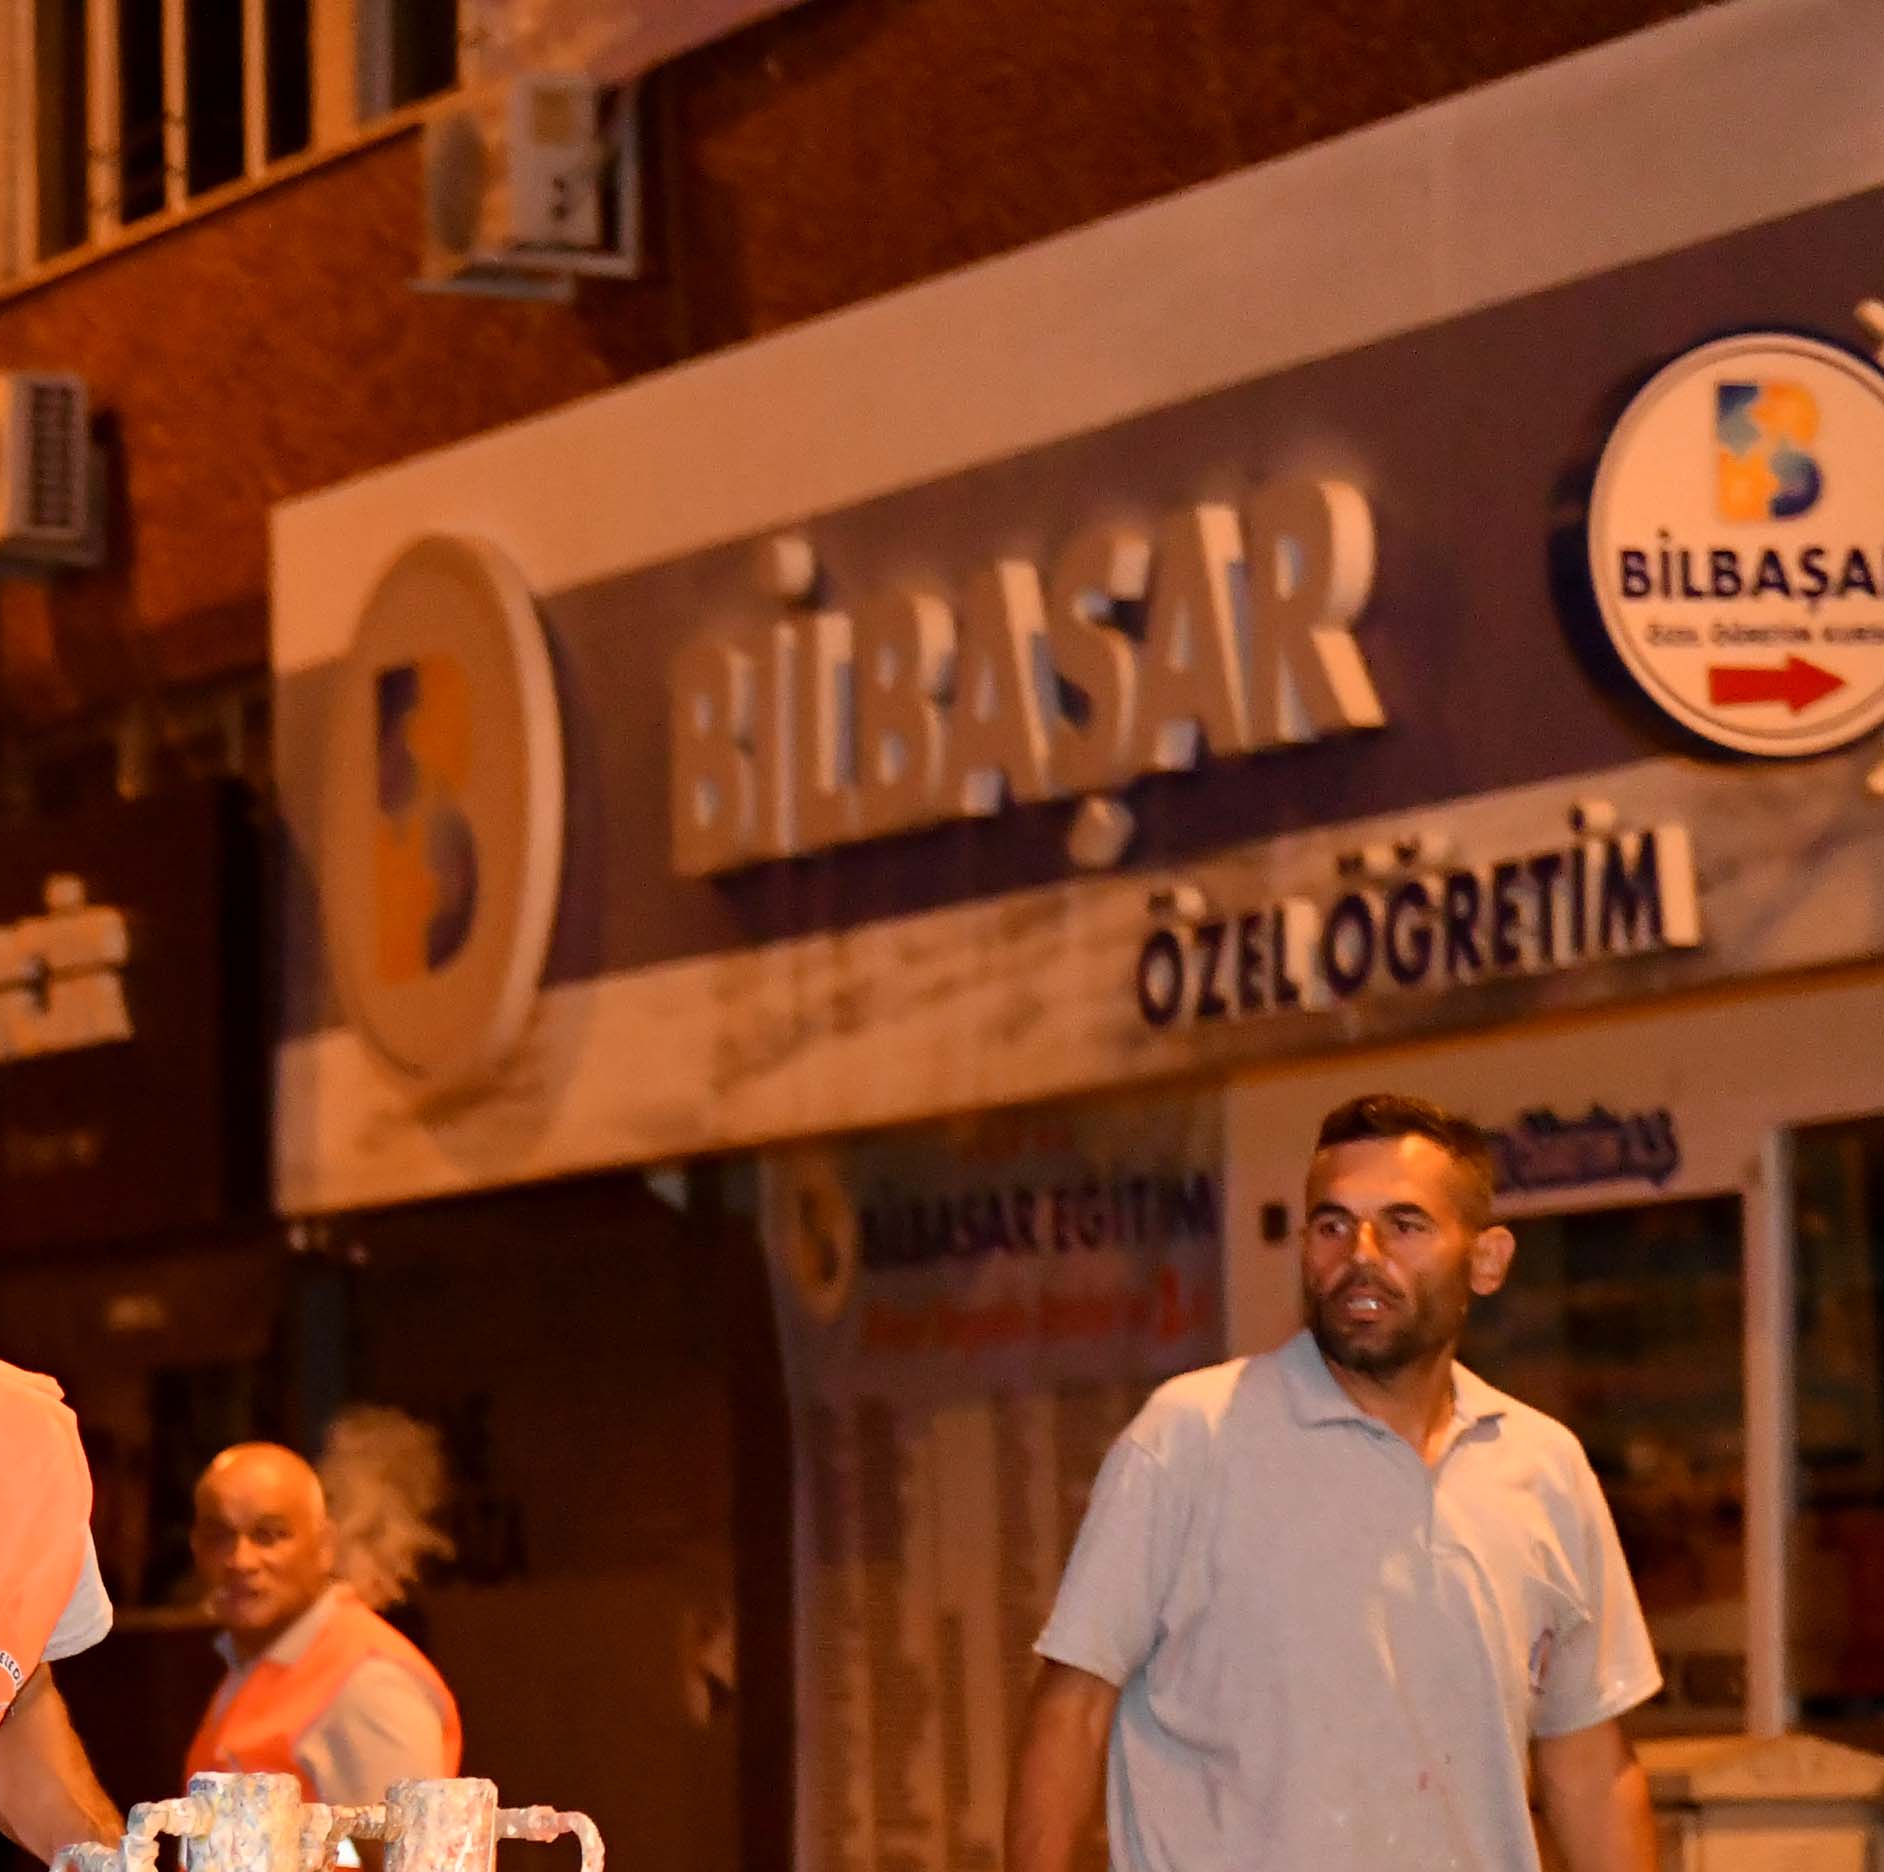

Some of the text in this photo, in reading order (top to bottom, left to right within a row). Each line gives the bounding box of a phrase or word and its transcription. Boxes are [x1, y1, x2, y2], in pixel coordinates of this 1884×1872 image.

[672, 480, 1388, 880] BİLBAŞAR
[1619, 528, 1884, 613] BİLBAŞA
[1136, 802, 1698, 1028] ÖZEL ÖĞRETİM
